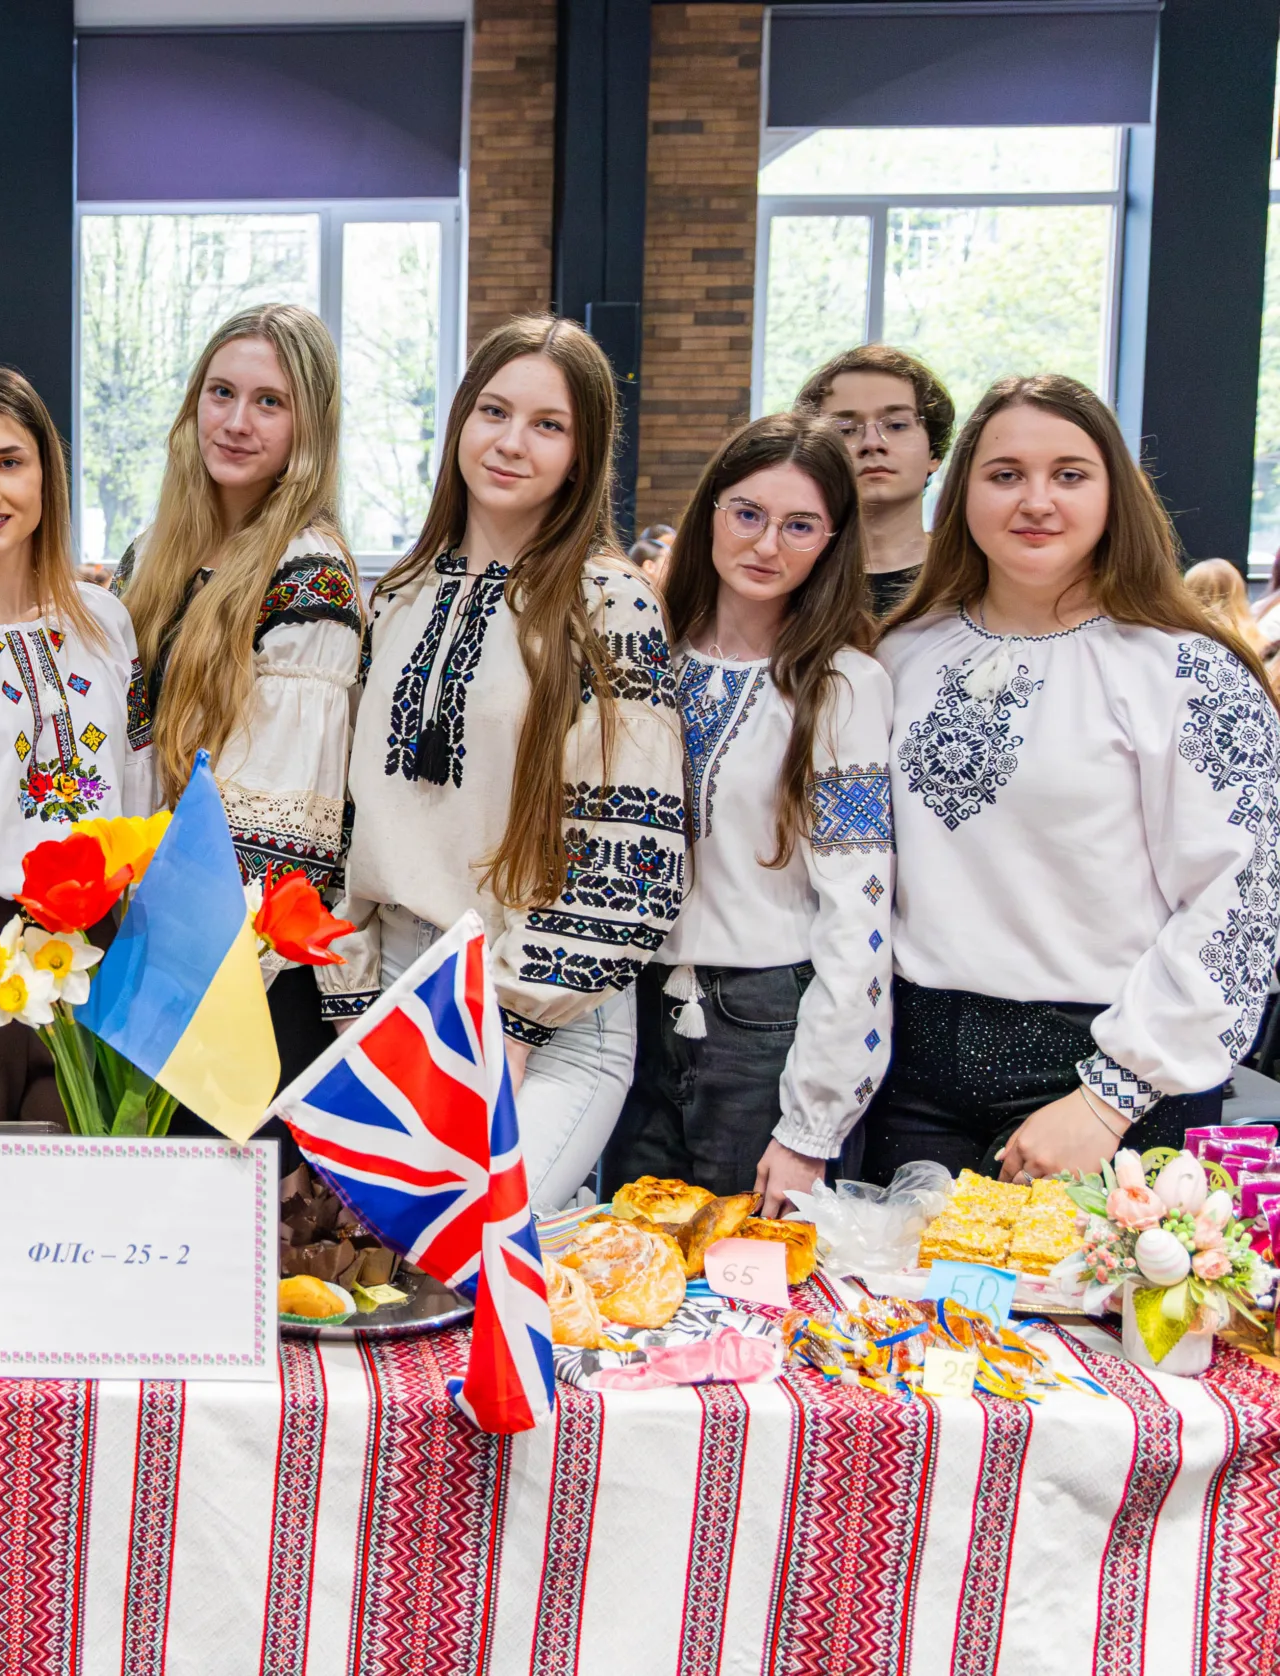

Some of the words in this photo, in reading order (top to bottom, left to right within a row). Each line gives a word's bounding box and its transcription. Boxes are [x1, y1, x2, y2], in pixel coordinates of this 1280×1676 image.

[28, 1242, 95, 1264] ФІЛс
[123, 1243, 152, 1265] 25
[176, 1244, 191, 1265] 2
[722, 1262, 760, 1286] 65
[950, 1274, 1000, 1312] 50
[942, 1359, 976, 1389] 25
